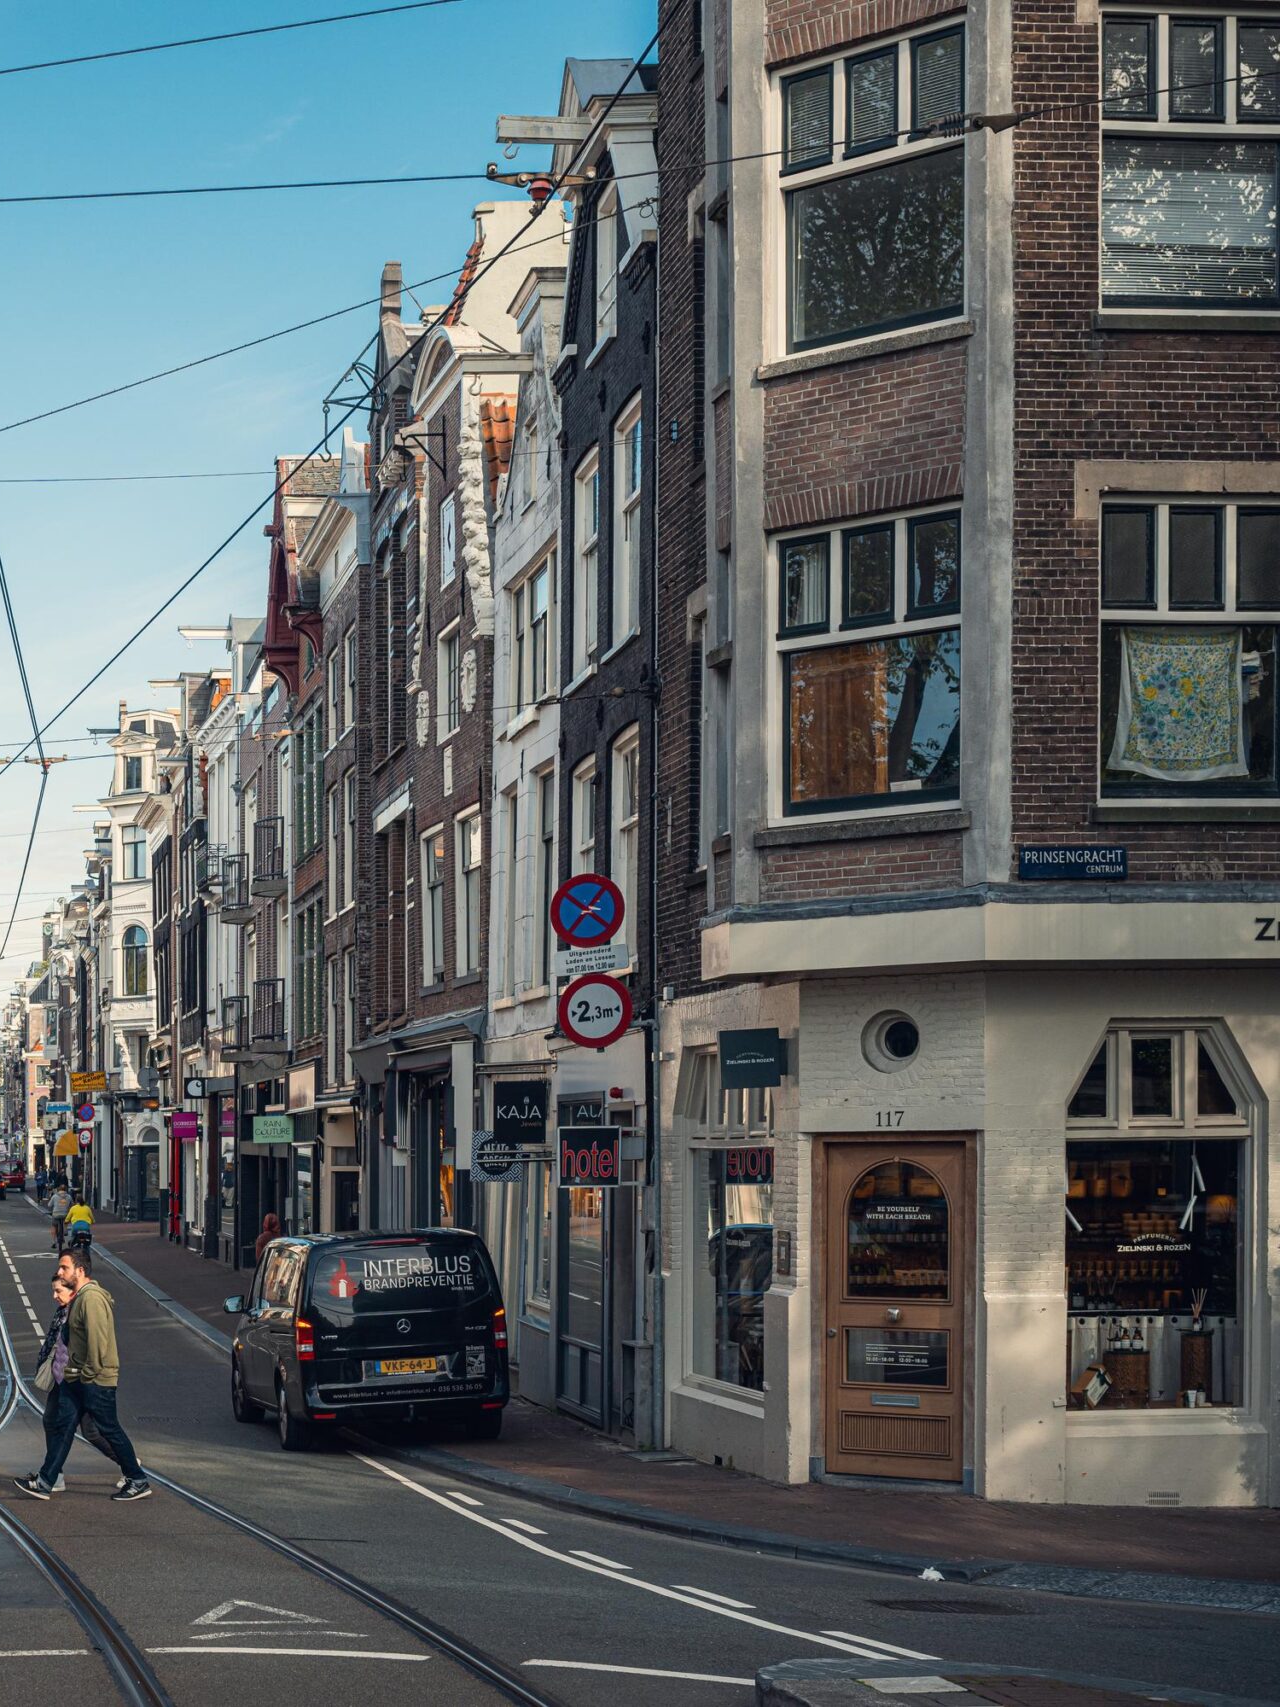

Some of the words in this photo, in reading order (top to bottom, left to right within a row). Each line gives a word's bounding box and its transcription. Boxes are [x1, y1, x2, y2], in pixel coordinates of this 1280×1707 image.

[1025, 850, 1123, 863] PRINSENGRACHT
[1086, 865, 1123, 873] CENTRUM
[569, 947, 612, 957] Uitgezonderd
[497, 1104, 542, 1119] KAJA
[875, 1111, 904, 1127] 117
[255, 1128, 291, 1136] COUTURE
[561, 1139, 619, 1178] hotel
[1133, 1233, 1176, 1243] PERFUMERIE
[1164, 1243, 1191, 1251] ROZEN
[363, 1255, 471, 1277] INTERBLUS
[364, 1274, 474, 1291] BRANDPREVENTIE
